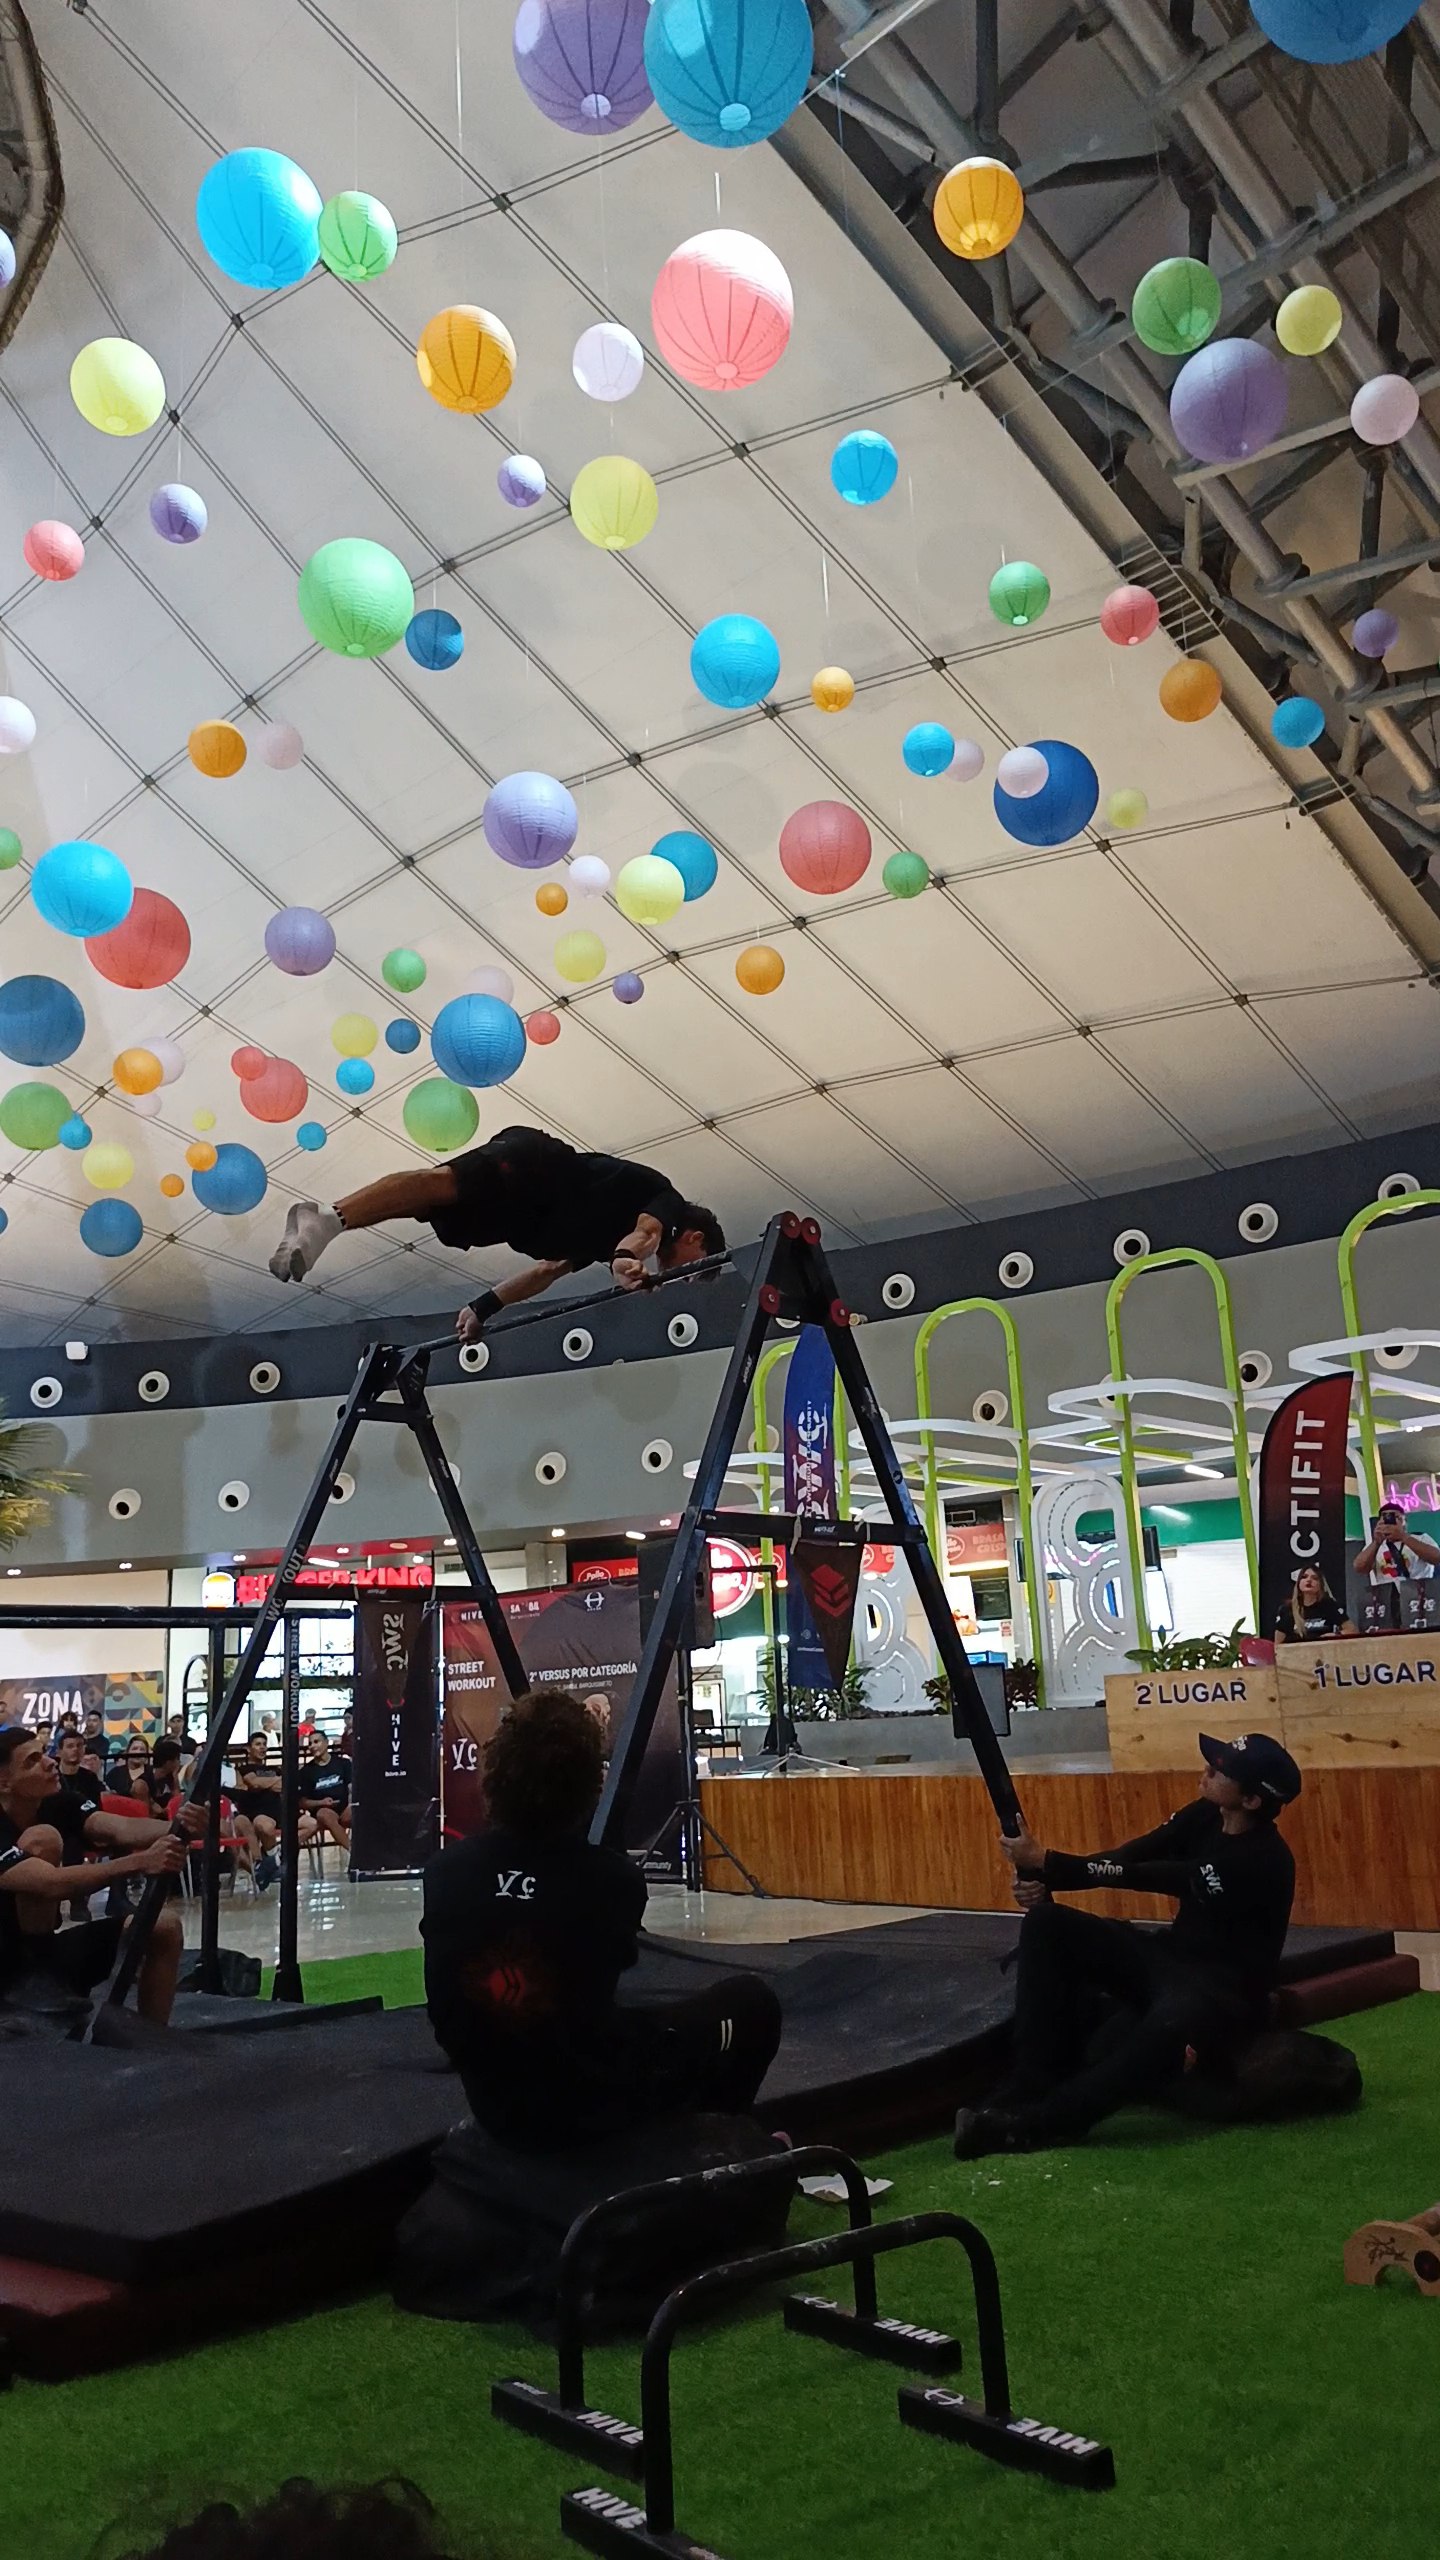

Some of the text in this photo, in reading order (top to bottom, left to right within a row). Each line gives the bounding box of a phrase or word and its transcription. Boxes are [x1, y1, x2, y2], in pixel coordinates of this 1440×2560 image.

[448, 1661, 485, 1675] STREET
[538, 1668, 570, 1681] VERSUS
[571, 1667, 589, 1679] POR
[590, 1660, 638, 1677] CATEGORÍA
[1335, 1661, 1437, 1688] LUGAR
[448, 1677, 496, 1691] WORKOUT
[1158, 1681, 1247, 1705] LUGAR
[22, 1690, 84, 1725] ZONA
[873, 2317, 949, 2344] HIVE
[1006, 2417, 1100, 2455] HIVE
[572, 2486, 648, 2529] HIVE
